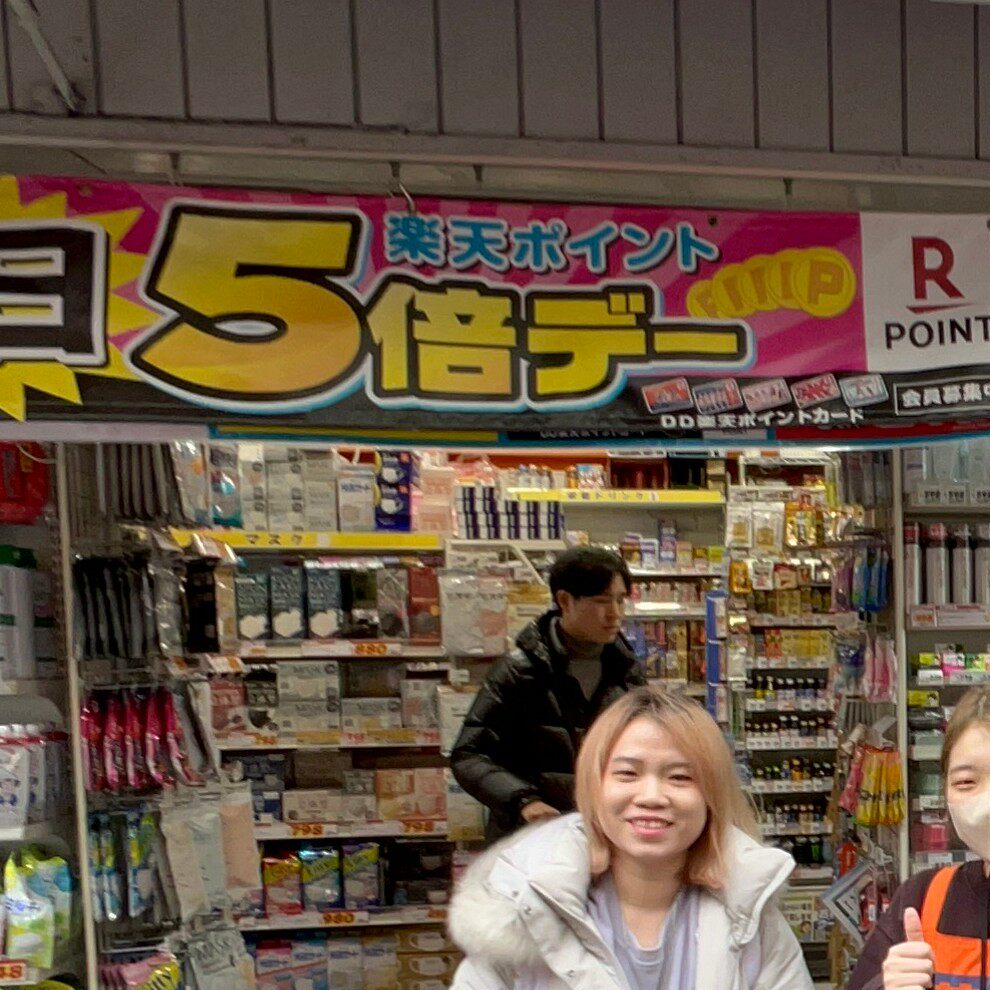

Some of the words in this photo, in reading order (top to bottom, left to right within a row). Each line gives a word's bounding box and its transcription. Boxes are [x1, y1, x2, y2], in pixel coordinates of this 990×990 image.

[386, 214, 719, 274] 楽天ポイント
[910, 235, 966, 300] R
[130, 204, 746, 402] 5倍デー
